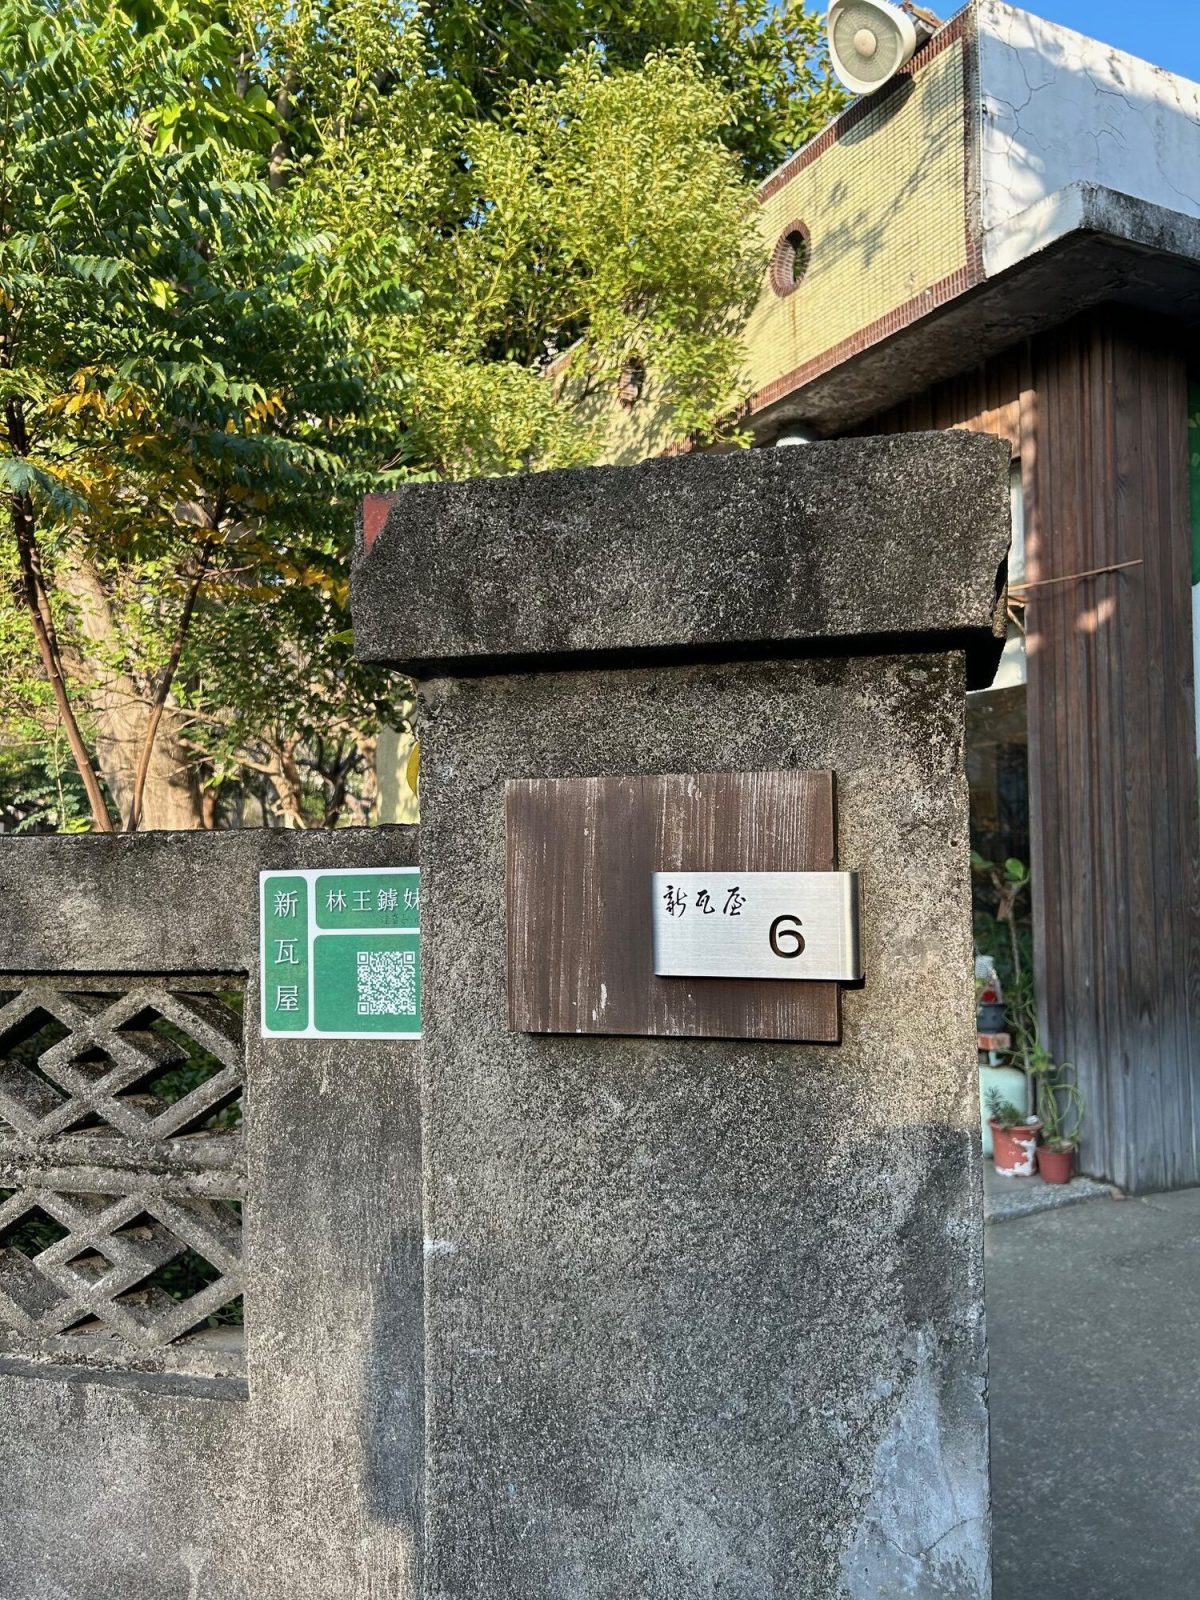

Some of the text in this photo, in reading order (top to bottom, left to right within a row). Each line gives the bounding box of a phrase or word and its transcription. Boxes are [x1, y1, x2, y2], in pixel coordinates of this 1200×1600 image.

[663, 885, 747, 918] 新瓦屋
[273, 889, 300, 1012] 新瓦屋
[769, 914, 806, 959] 6
